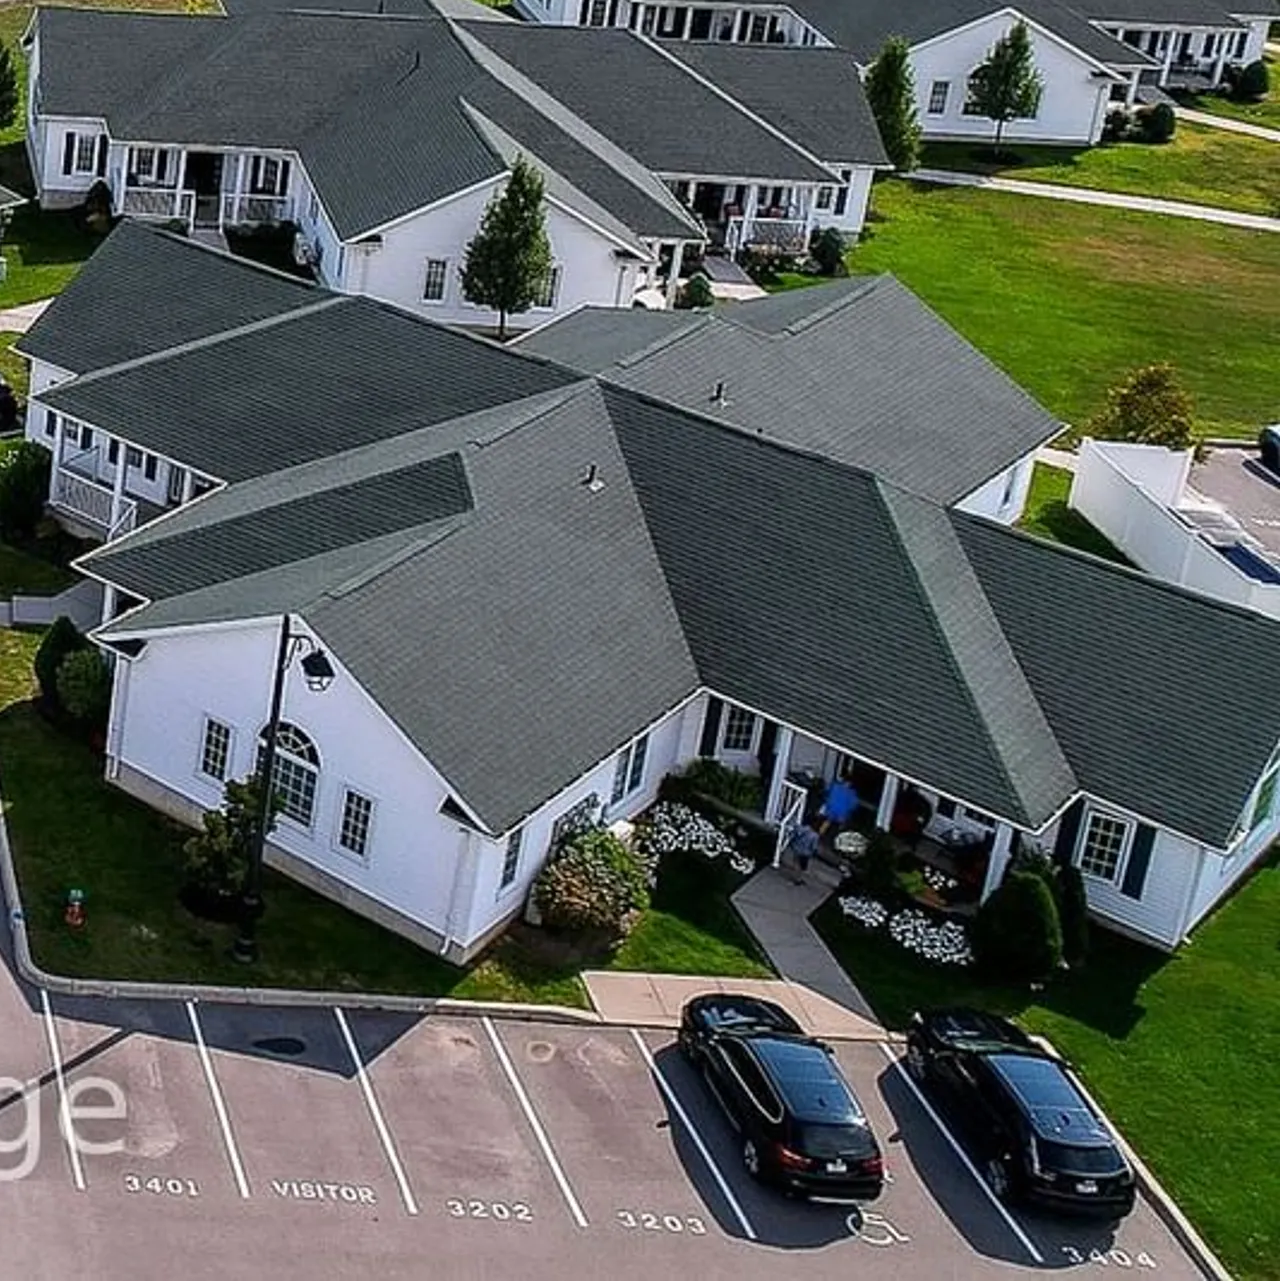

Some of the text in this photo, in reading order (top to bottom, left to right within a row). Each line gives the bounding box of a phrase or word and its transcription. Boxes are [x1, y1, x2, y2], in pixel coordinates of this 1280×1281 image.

[125, 1175, 199, 1196] 3401
[272, 1180, 377, 1204] VISITOR
[447, 1200, 533, 1221] 3202
[617, 1211, 706, 1235] 3203
